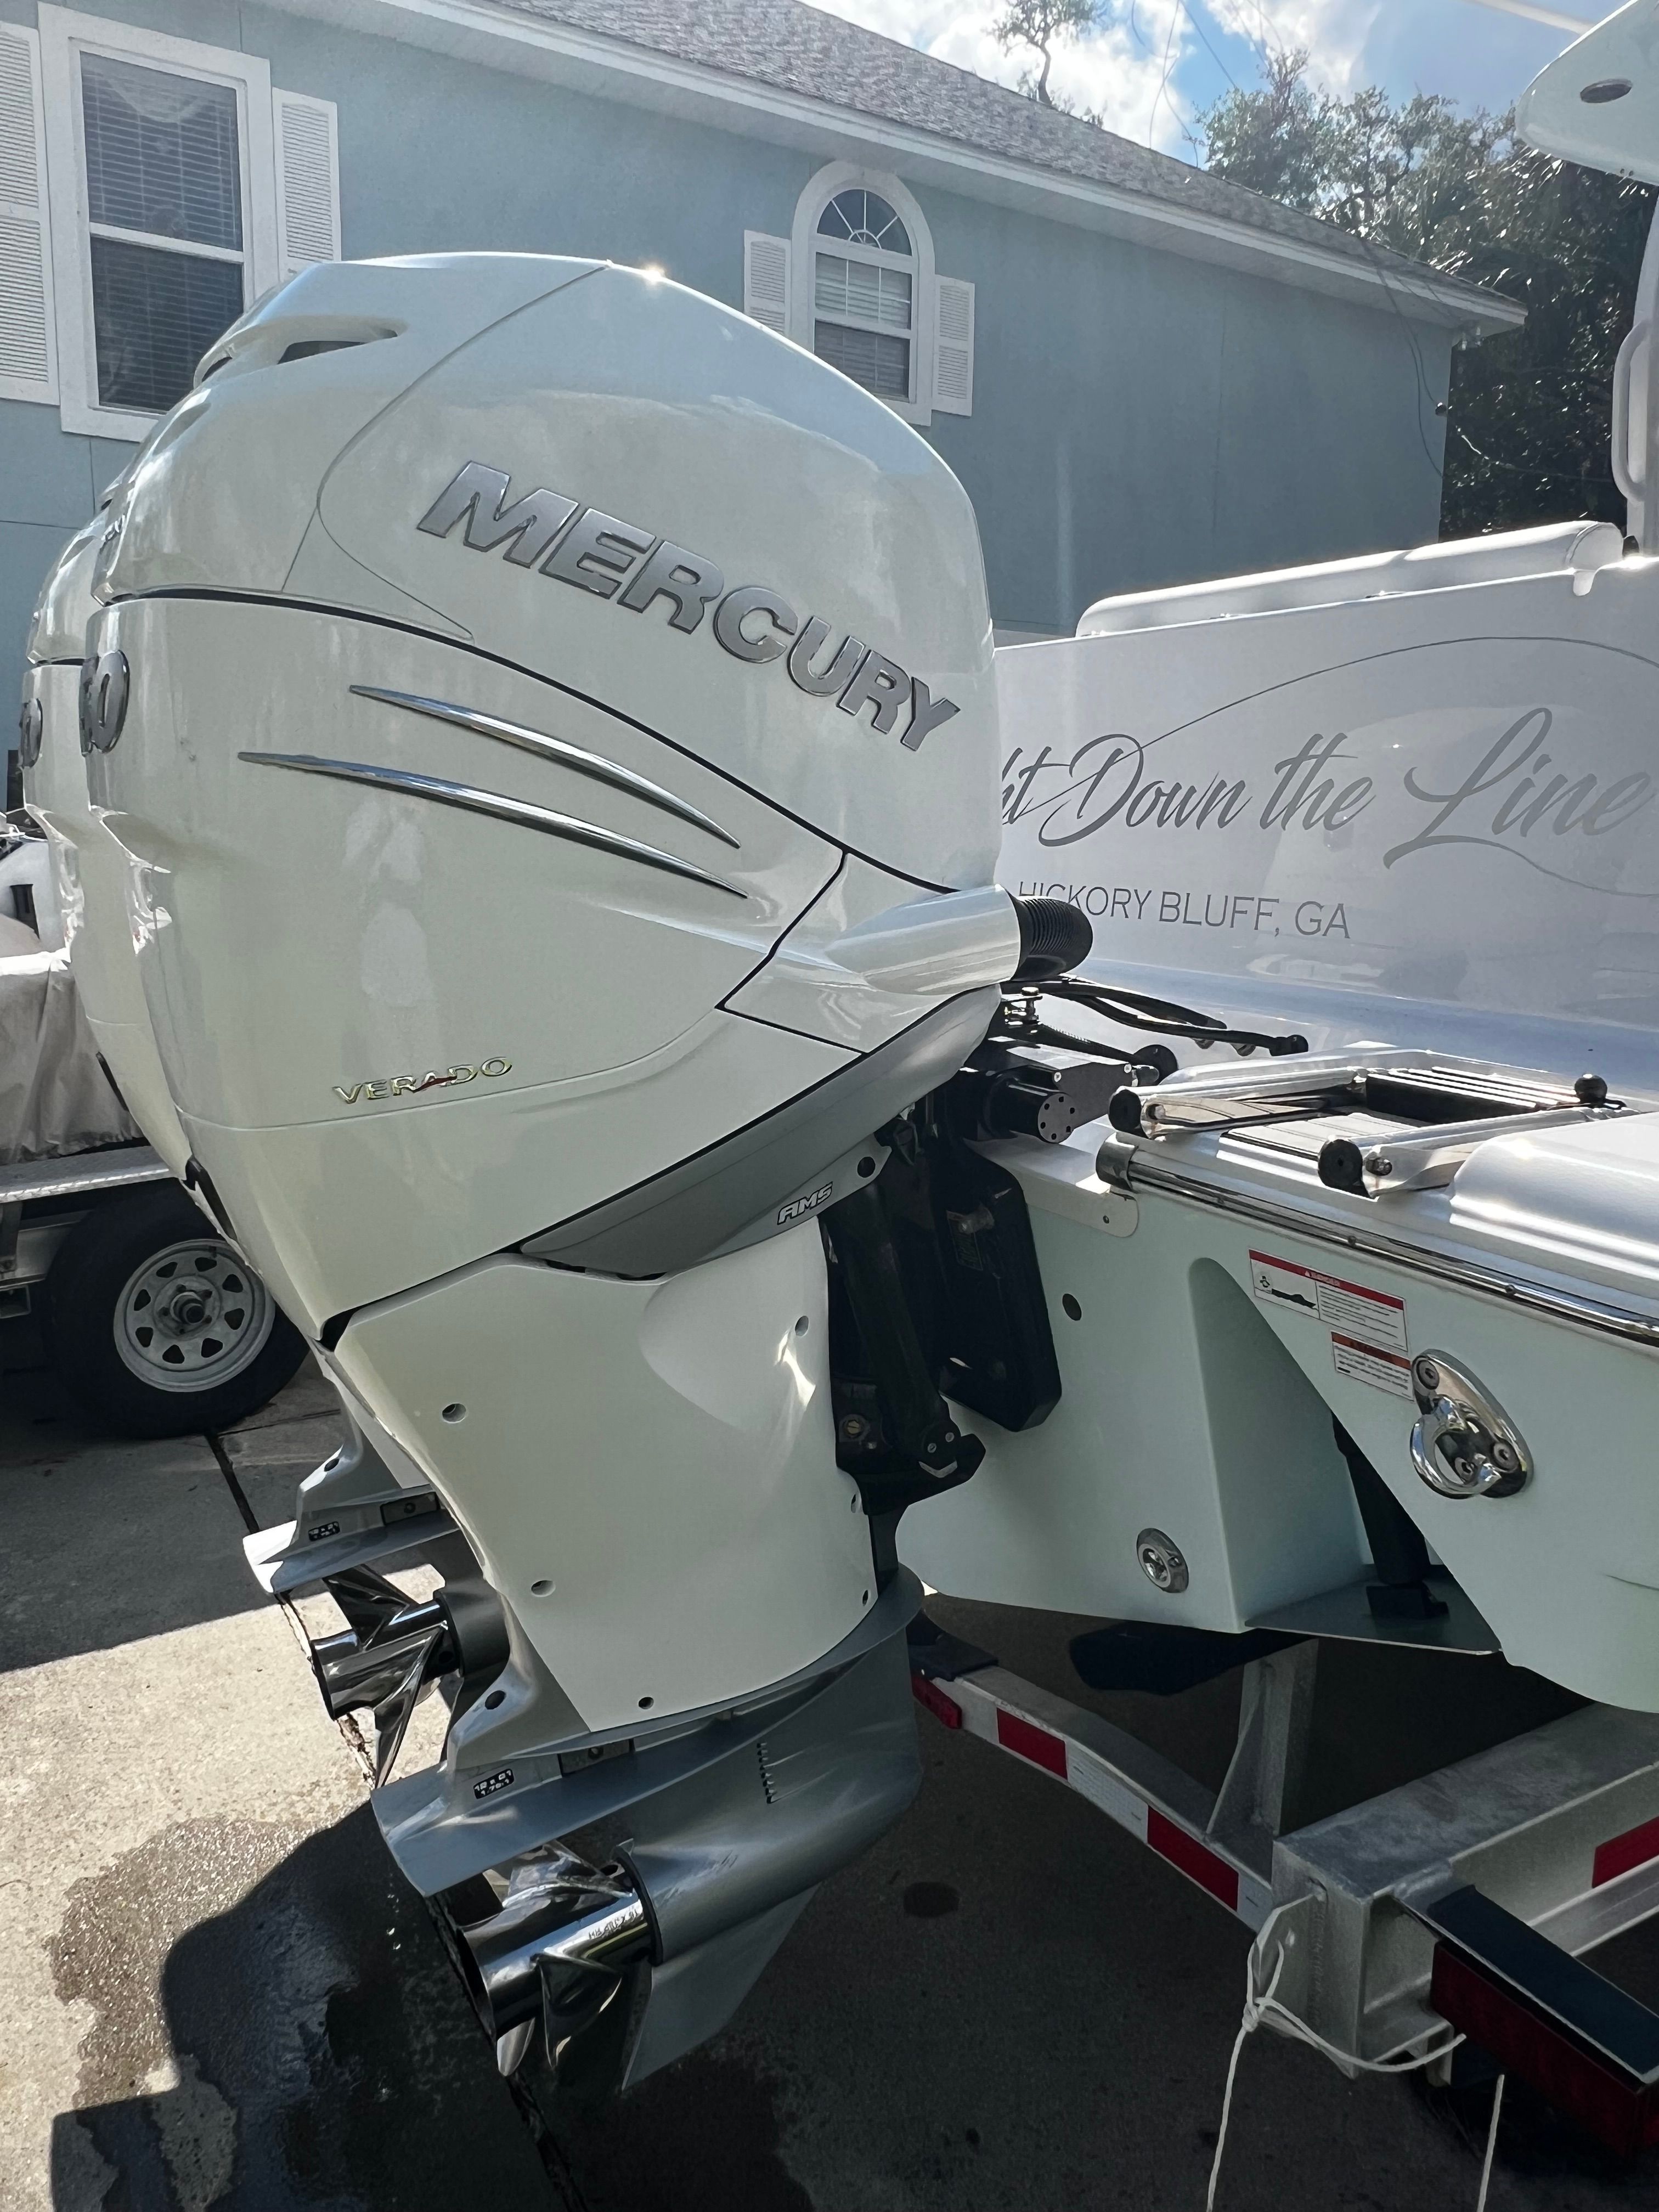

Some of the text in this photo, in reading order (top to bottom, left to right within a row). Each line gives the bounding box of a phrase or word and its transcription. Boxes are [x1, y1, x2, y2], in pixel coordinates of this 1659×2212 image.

[416, 460, 961, 752] MERCURY
[1038, 733, 1253, 847] Down
[1260, 732, 1376, 831] the
[1383, 707, 1658, 870] Line
[1159, 891, 1279, 938] BLUFF,
[1295, 901, 1351, 939] GA
[332, 1056, 512, 1104] VERADO
[777, 1181, 833, 1225] AMS
